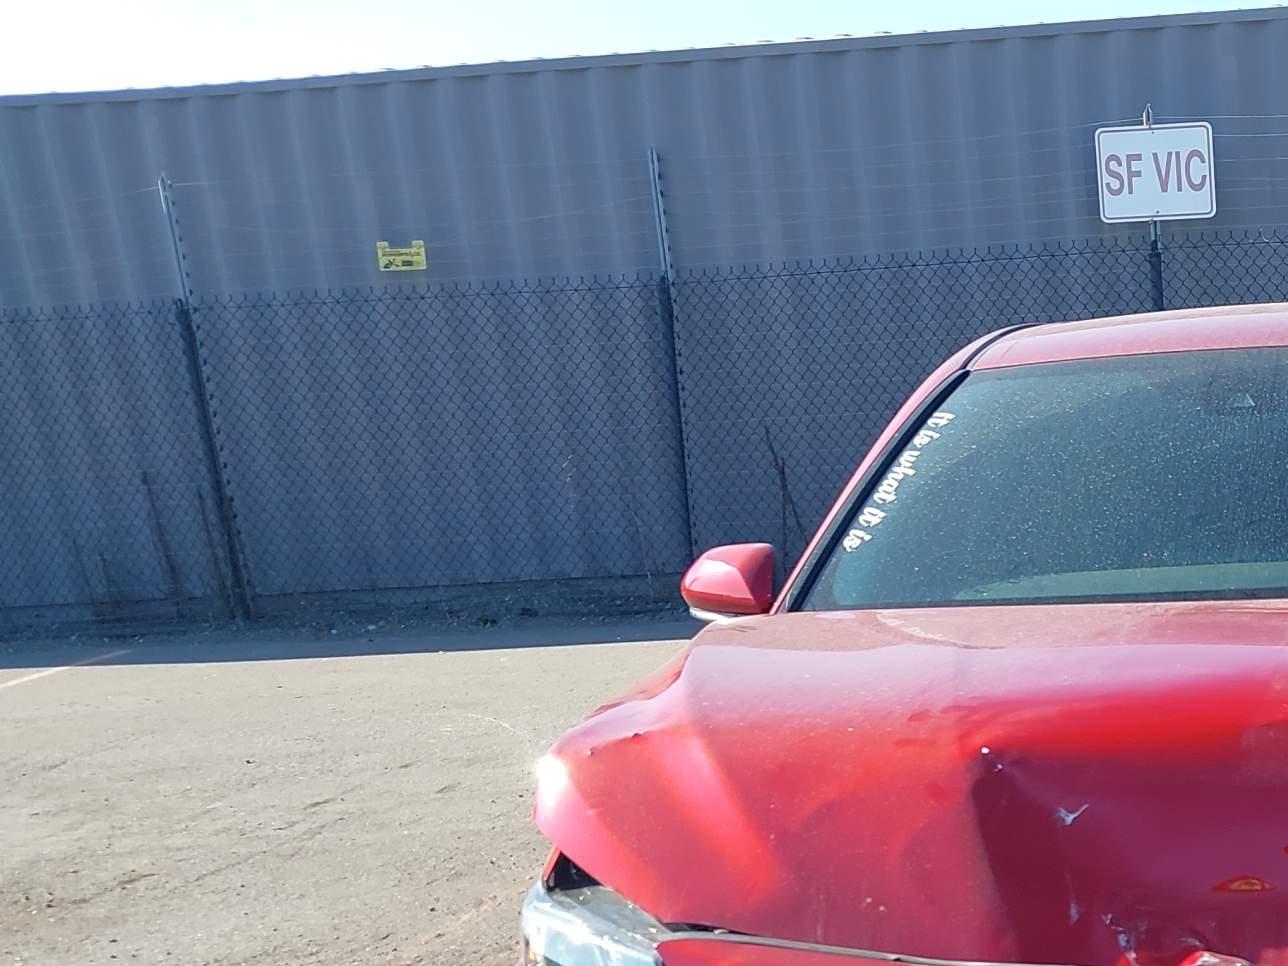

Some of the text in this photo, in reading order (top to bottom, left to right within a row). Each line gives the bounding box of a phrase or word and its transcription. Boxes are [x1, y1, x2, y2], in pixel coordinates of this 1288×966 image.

[1104, 149, 1207, 196] SF VIC
[912, 429, 942, 449] is
[873, 450, 921, 504] what
[842, 529, 873, 552] is
